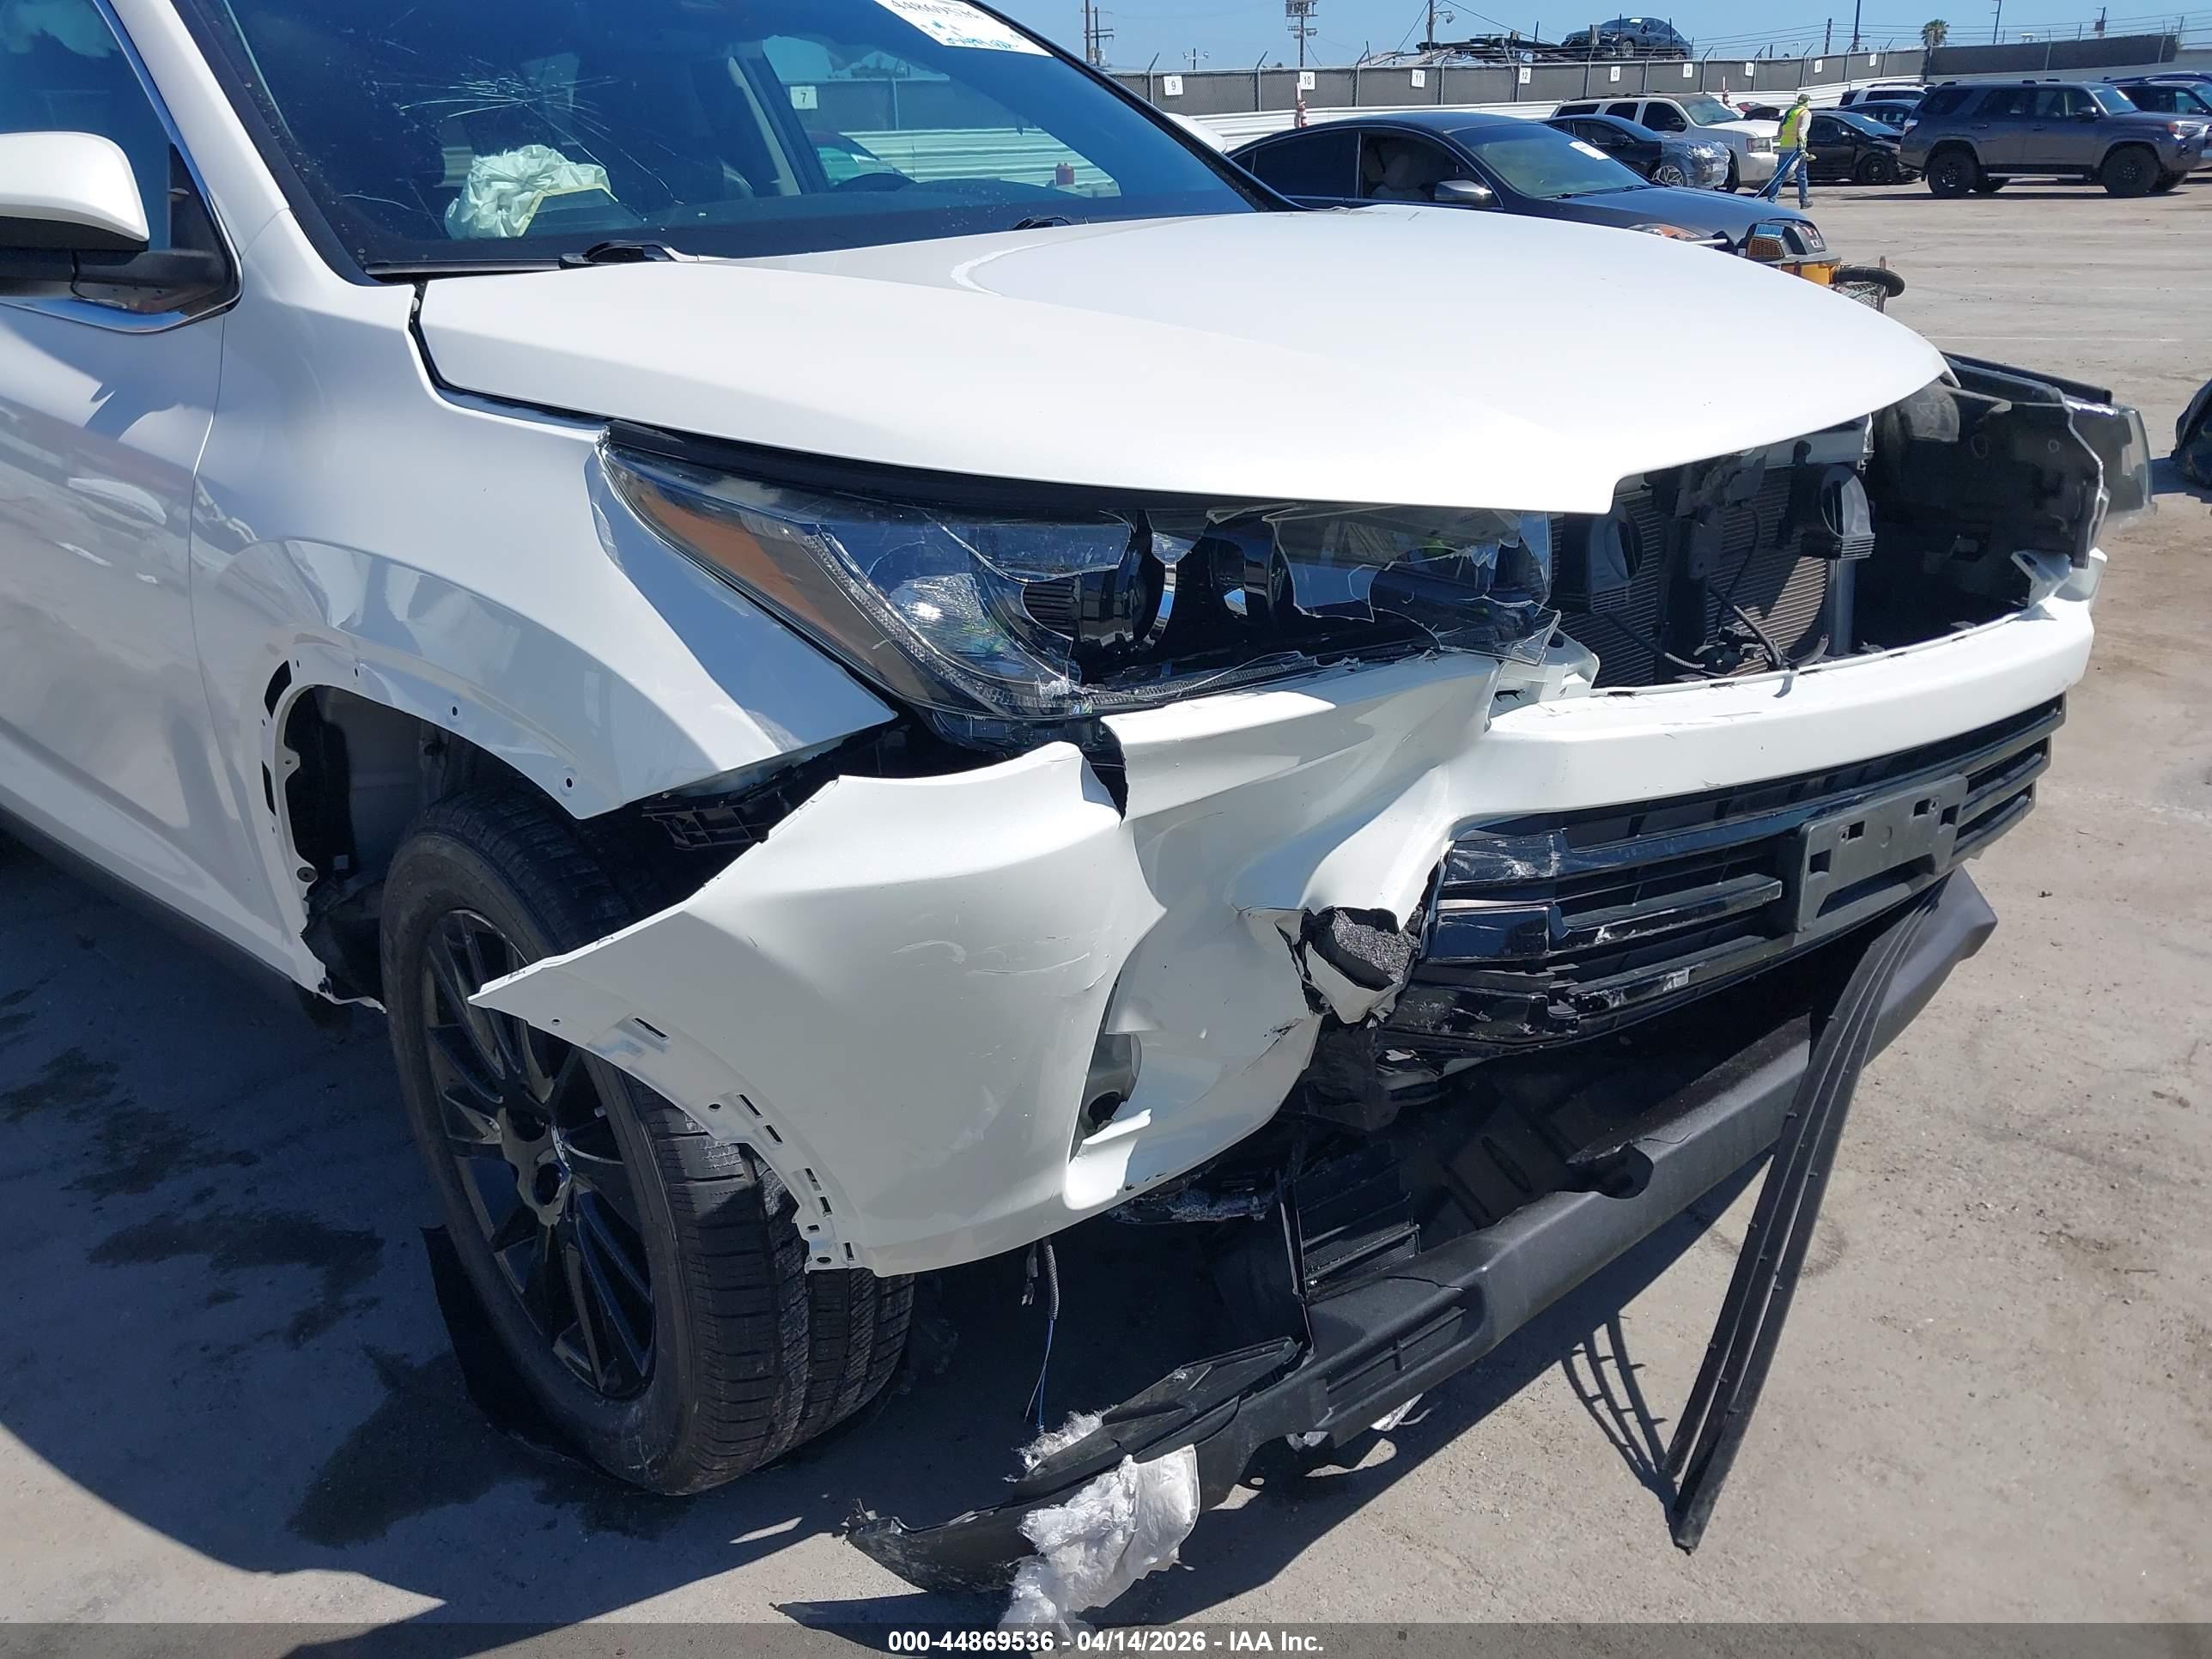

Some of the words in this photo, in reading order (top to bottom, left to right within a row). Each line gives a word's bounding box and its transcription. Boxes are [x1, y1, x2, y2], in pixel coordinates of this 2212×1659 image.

[1522, 70, 1528, 80] 12
[1304, 76, 1311, 85] 10
[1171, 81, 1176, 90] 9
[801, 93, 807, 104] 7
